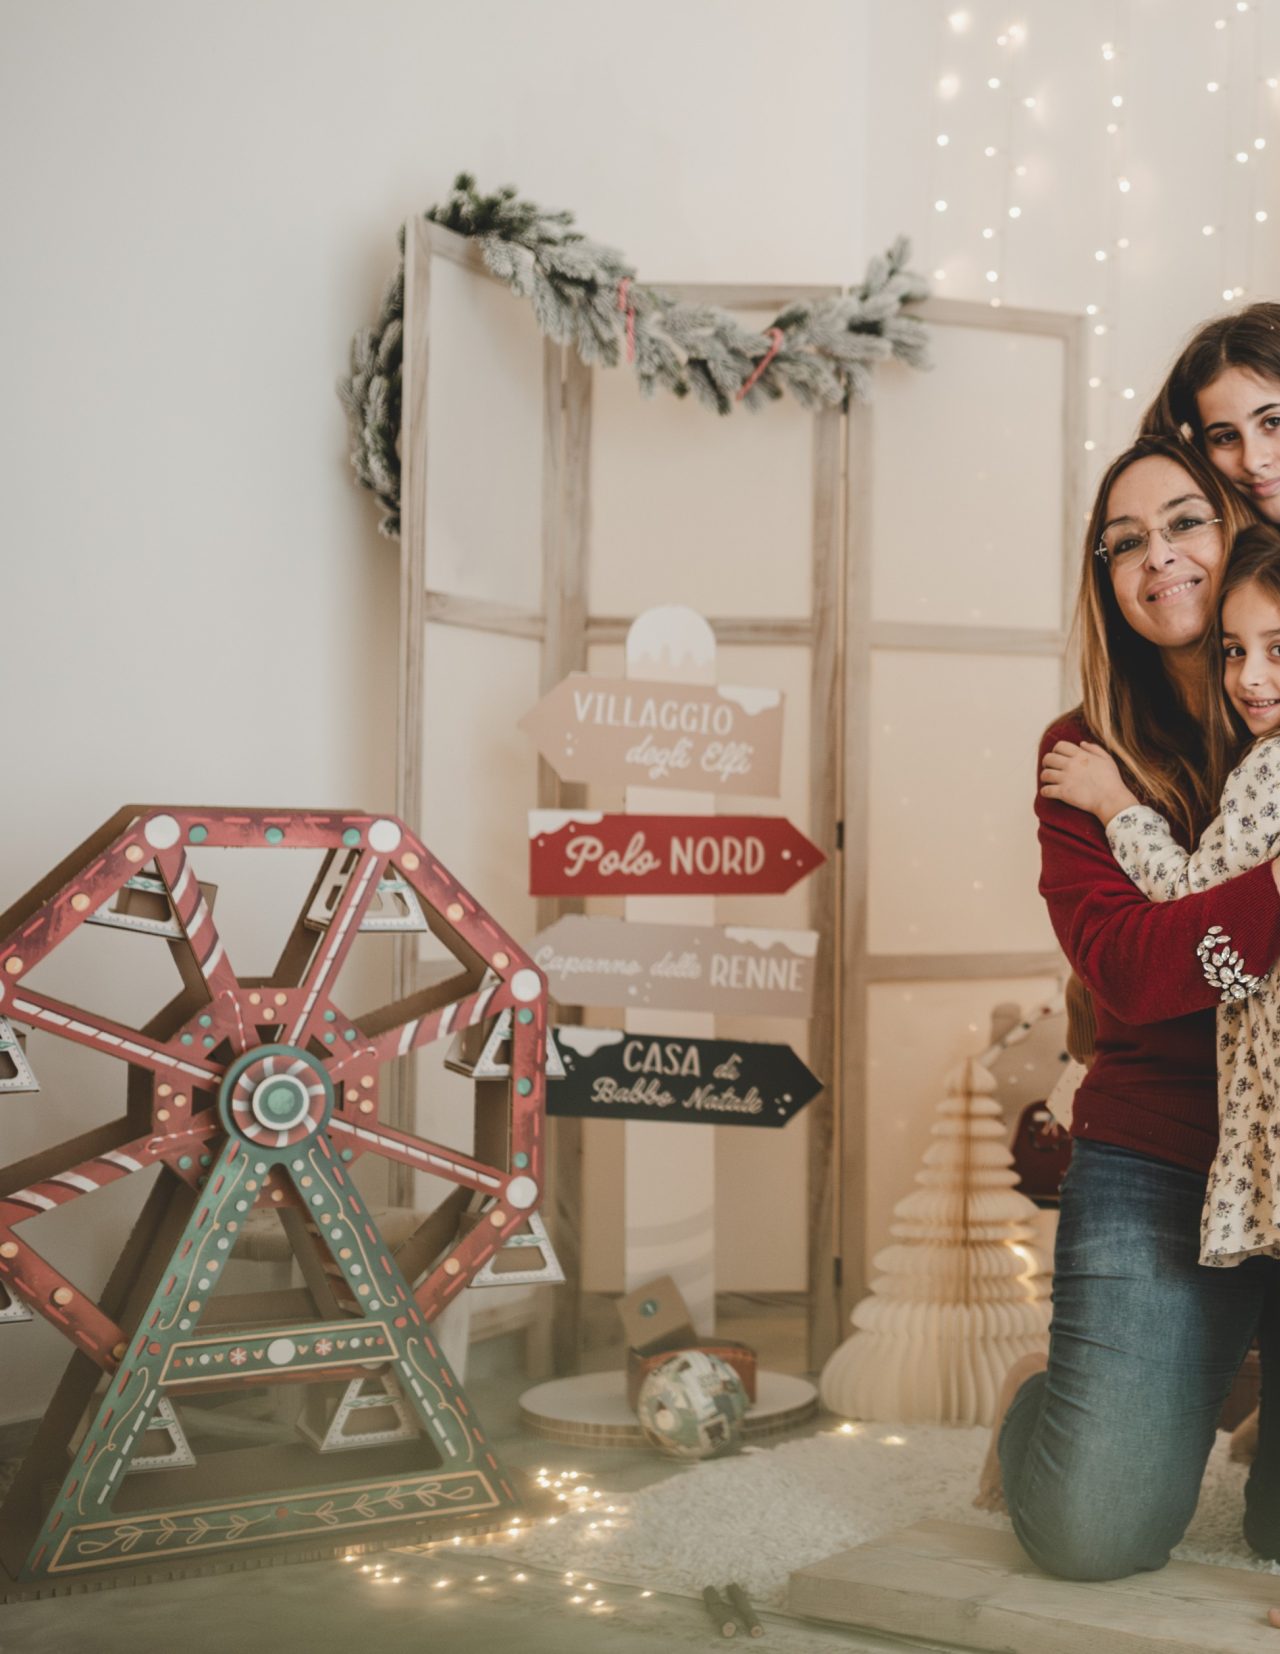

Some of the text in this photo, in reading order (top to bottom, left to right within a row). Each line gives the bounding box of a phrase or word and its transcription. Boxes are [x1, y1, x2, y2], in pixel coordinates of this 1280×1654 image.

[573, 689, 733, 735] VILLAGGIO
[625, 734, 755, 782] degli Elfi
[563, 830, 765, 877] Polo NORD
[709, 953, 806, 992] RENNE
[622, 1040, 743, 1081] CASA di
[590, 1076, 763, 1114] Babbo Natale
